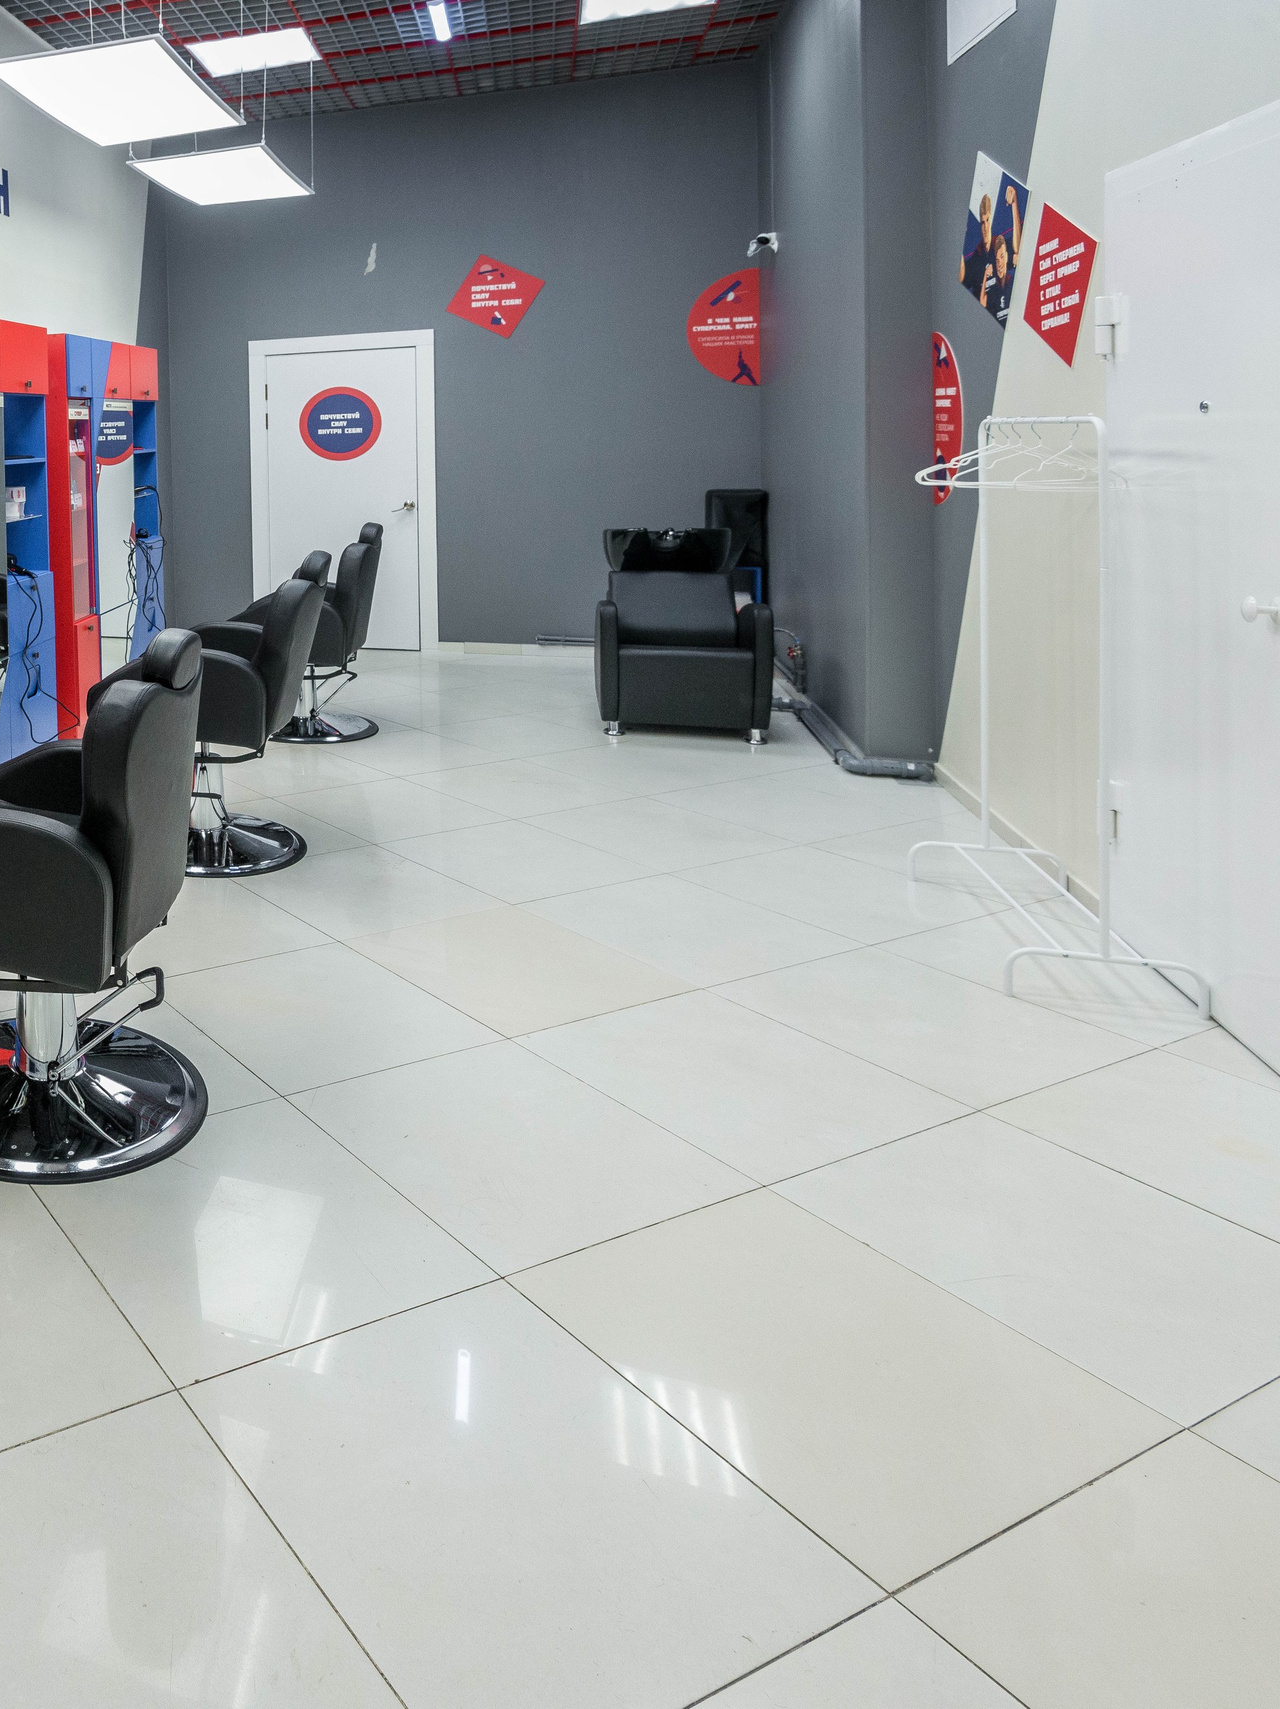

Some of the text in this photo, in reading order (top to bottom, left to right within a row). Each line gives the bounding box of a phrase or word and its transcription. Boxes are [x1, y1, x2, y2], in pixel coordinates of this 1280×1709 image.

[1053, 242, 1085, 265] СУПЕРМЕНА
[471, 281, 516, 292] ПОЧУВСТВУЙ
[1040, 290, 1044, 301] С
[471, 298, 522, 308] ВНУТРИ СЕБЯ!
[1056, 300, 1060, 310] С
[320, 412, 360, 421] ПОЧУВСТВУЙ
